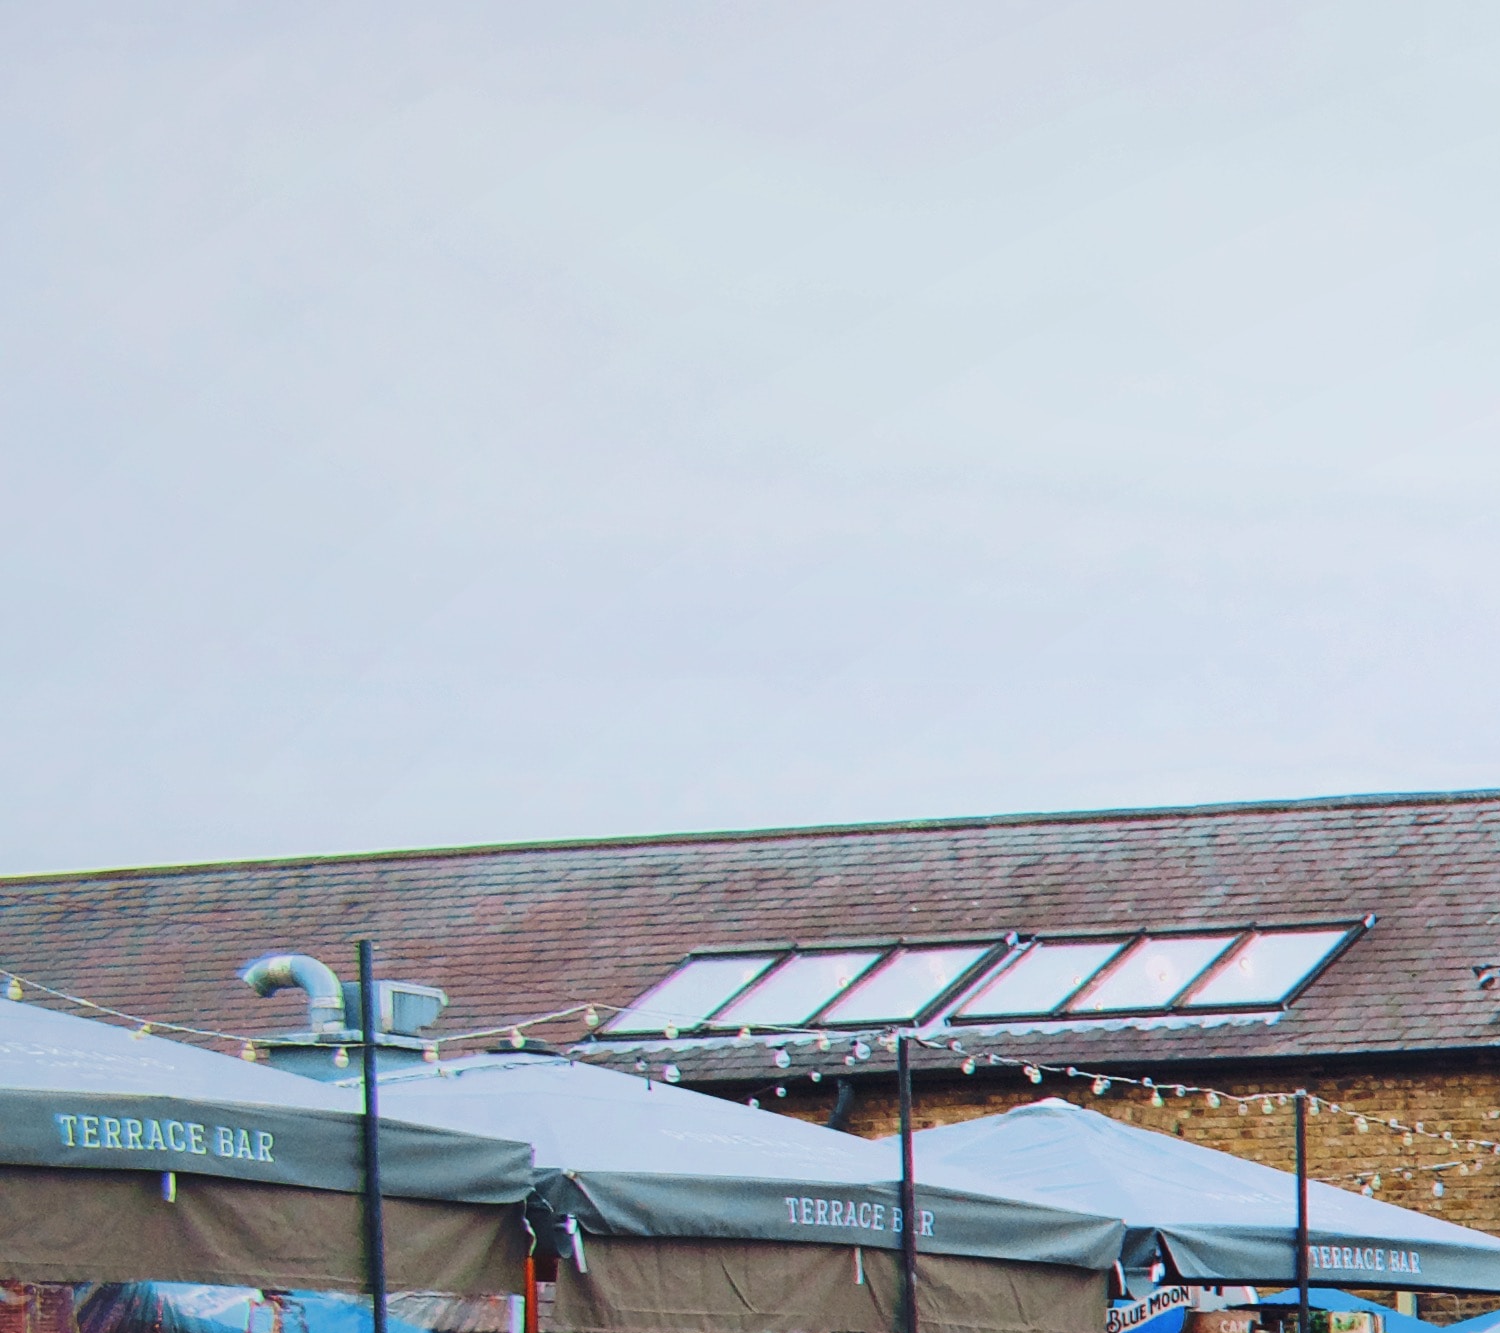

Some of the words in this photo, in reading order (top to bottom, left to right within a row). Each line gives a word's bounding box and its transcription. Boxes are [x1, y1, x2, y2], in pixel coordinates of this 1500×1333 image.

[54, 1112, 207, 1155] TERRACE
[214, 1126, 275, 1163] BAR
[785, 1197, 886, 1232] TERRACE
[891, 1206, 936, 1237] BR
[1309, 1245, 1385, 1271] TERRACE
[1388, 1250, 1423, 1275] BAR
[1149, 1285, 1191, 1316] MOON
